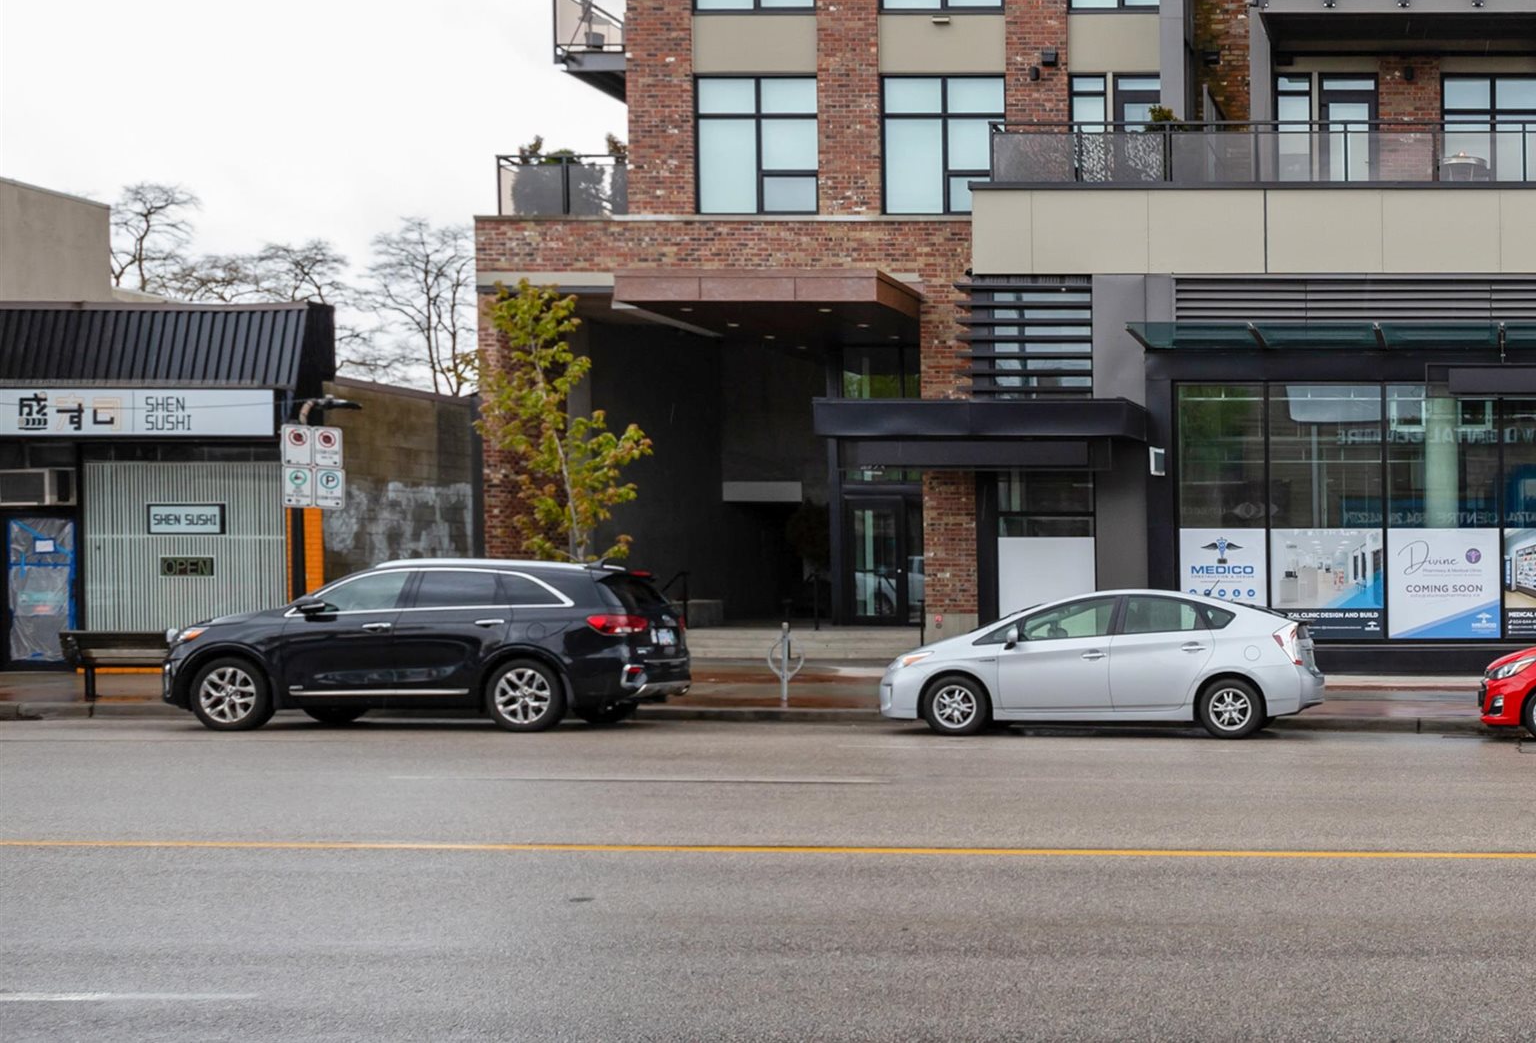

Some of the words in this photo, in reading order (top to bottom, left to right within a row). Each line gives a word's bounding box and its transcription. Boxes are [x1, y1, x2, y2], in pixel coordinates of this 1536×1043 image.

[145, 396, 185, 413] SHEN
[145, 414, 192, 431] SUSHI
[152, 513, 181, 526] SHEN
[184, 513, 217, 526] SUSHI
[1398, 540, 1459, 576] Divine
[163, 559, 208, 575] OPEN
[1191, 565, 1255, 575] MEDICO
[1406, 584, 1449, 593] COMING
[1452, 584, 1483, 593] SOON
